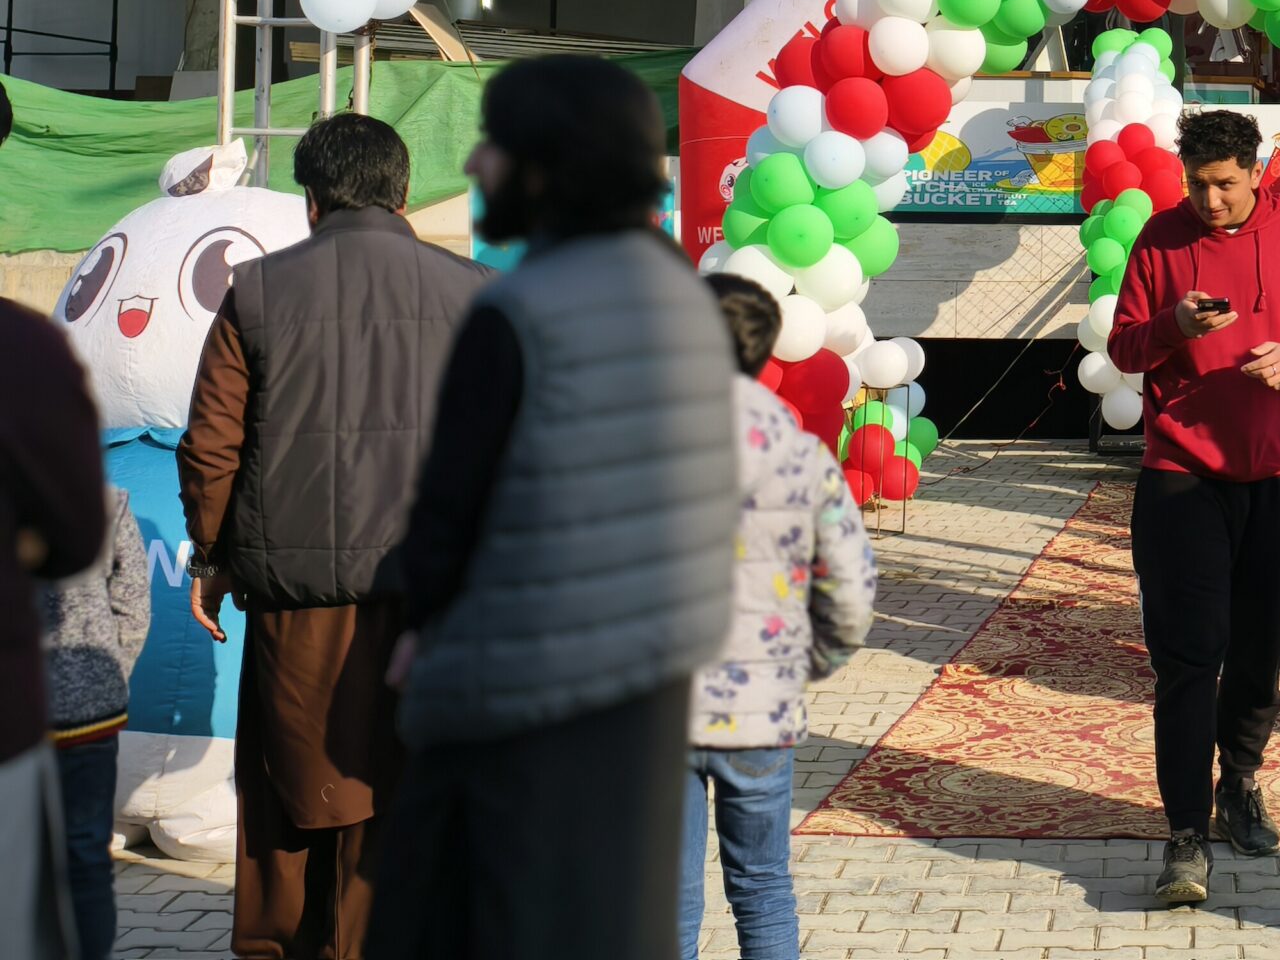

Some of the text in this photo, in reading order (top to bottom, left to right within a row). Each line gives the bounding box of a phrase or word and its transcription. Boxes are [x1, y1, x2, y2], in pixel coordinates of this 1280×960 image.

[903, 169, 993, 181] PIONEER
[910, 181, 970, 193] TCHA
[901, 192, 997, 206] BUCKET
